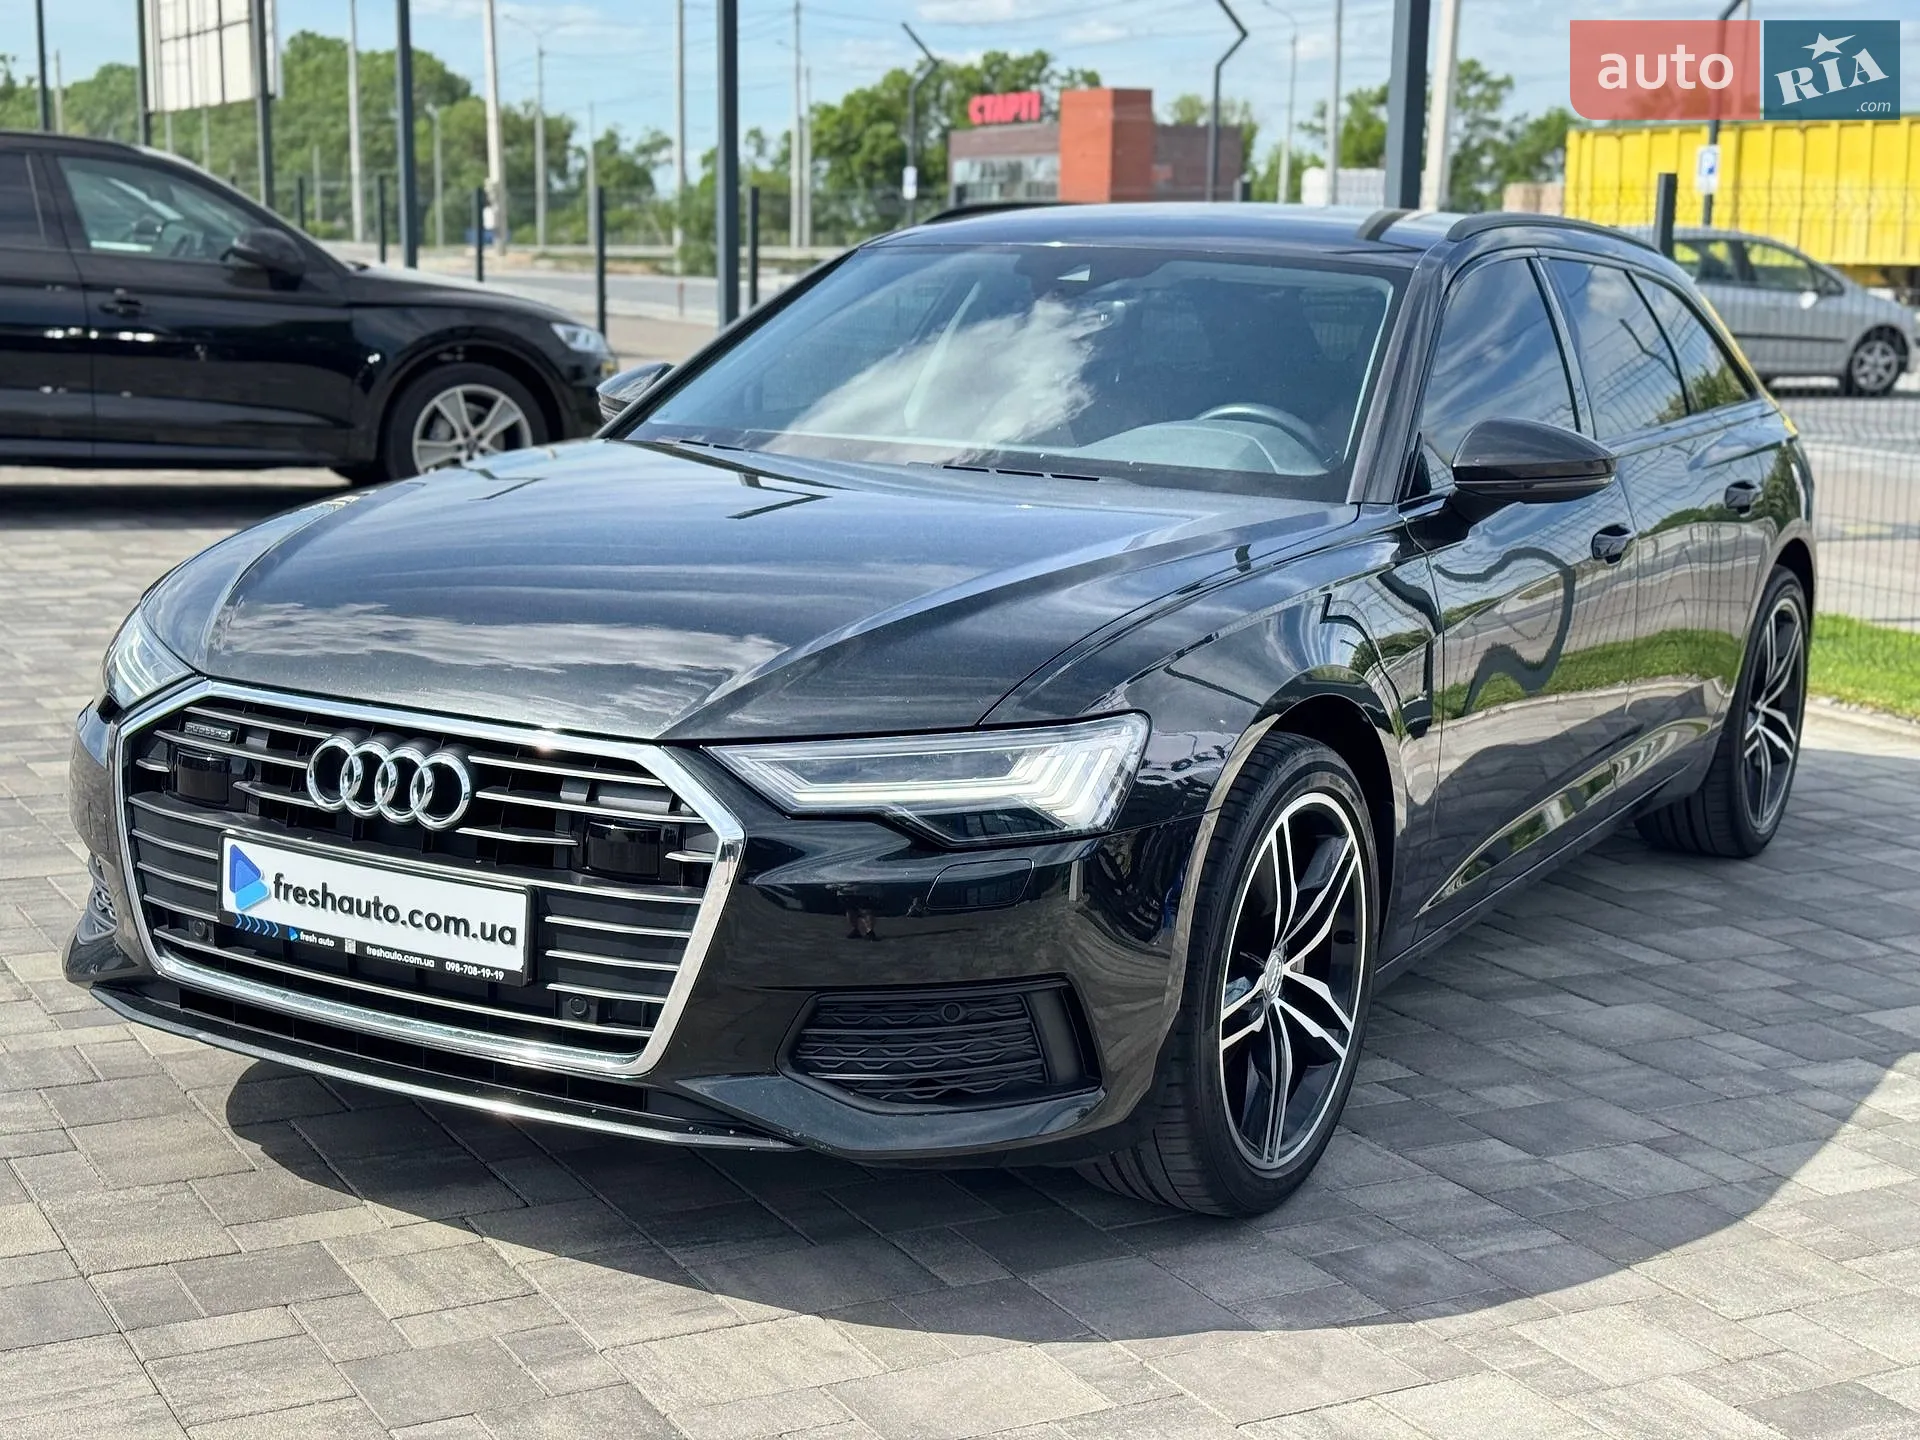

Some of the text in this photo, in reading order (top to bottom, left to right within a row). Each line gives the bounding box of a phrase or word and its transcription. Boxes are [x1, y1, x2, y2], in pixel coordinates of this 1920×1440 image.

[273, 873, 517, 945] freshauto.com.ua
[300, 931, 335, 947] fresh auto
[366, 945, 504, 981] freshauto.com.ua 098-708-19-19
